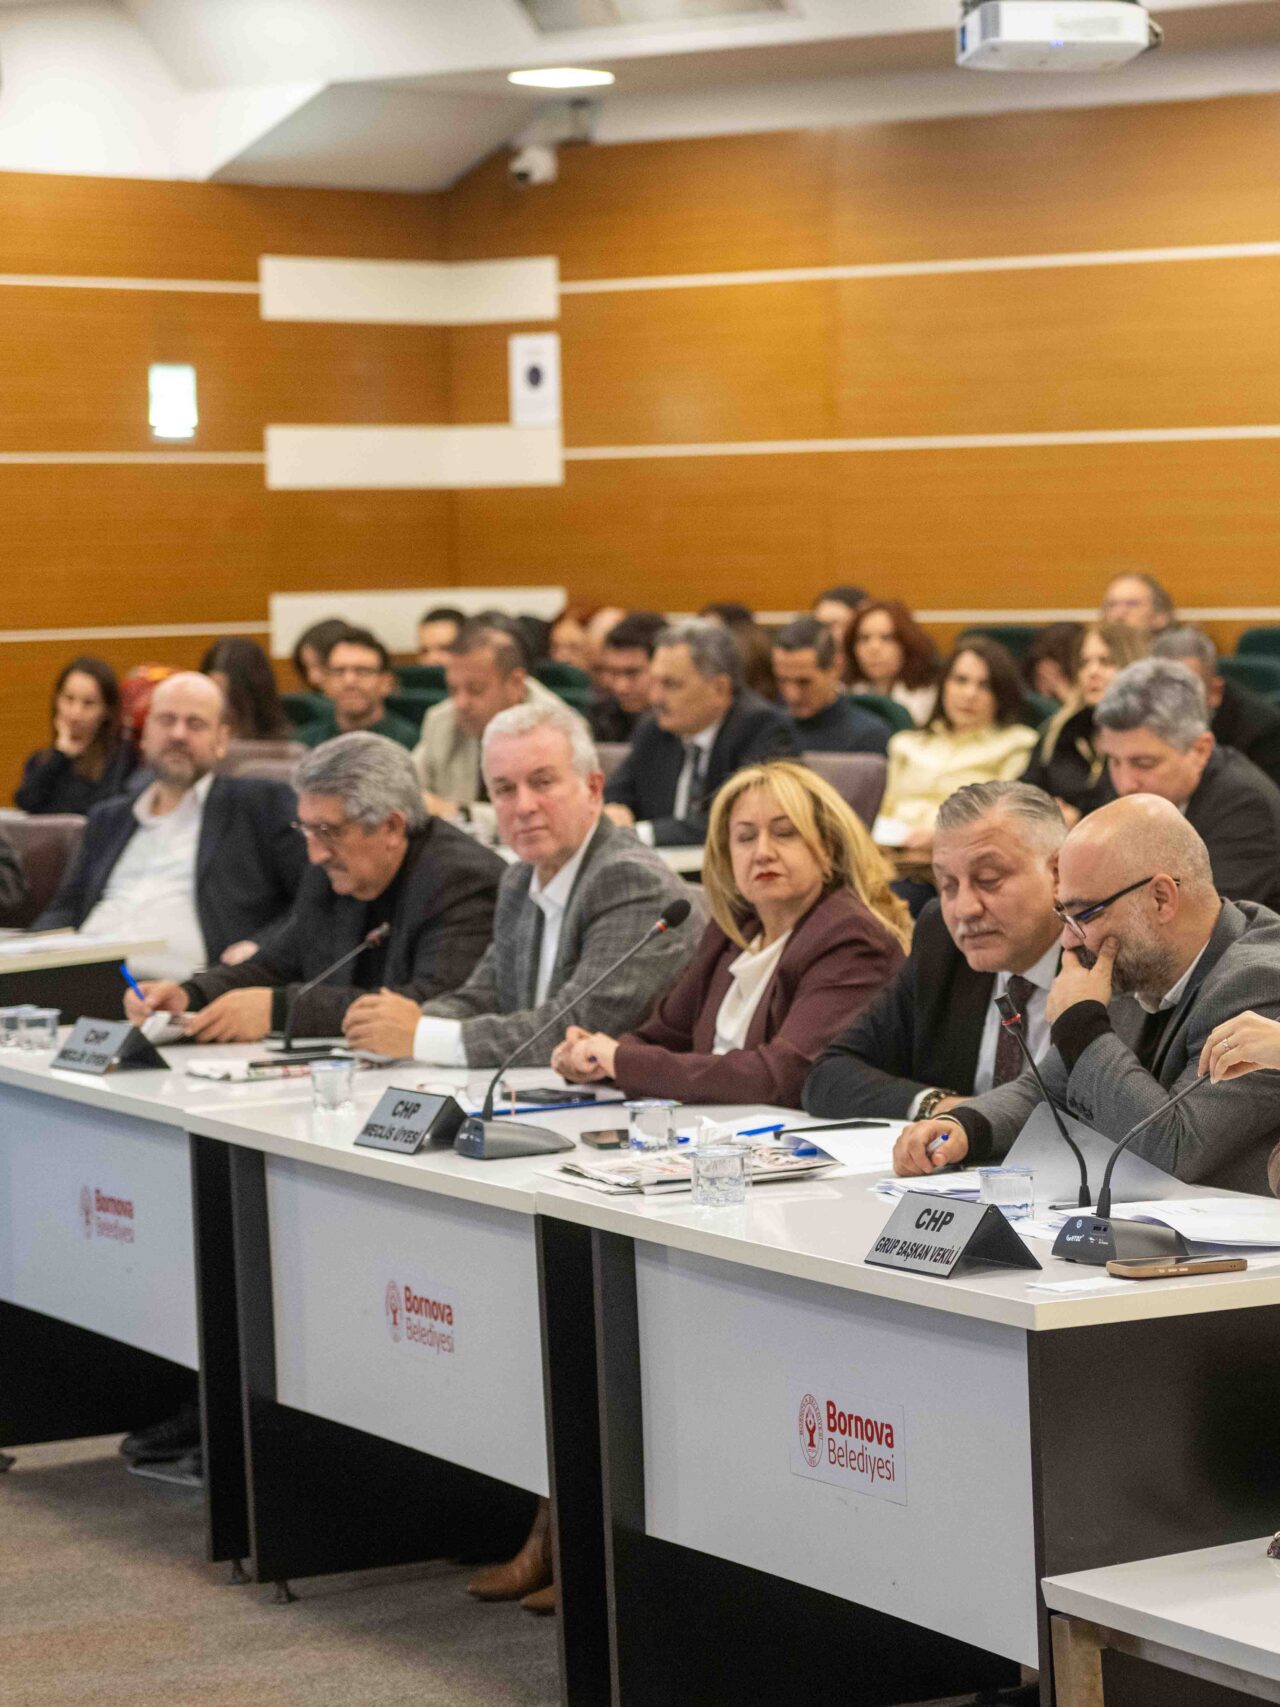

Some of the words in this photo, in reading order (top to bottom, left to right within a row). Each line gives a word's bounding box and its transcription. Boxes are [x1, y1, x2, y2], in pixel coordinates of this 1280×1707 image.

[392, 1101, 421, 1119] CHP
[95, 1188, 134, 1219] Bornova
[915, 1208, 954, 1232] CHP
[875, 1237, 901, 1254] GRUP
[896, 1240, 933, 1261] BAŞKAN
[928, 1245, 961, 1265] VEKİLİ
[404, 1285, 453, 1326] Bornova
[405, 1316, 454, 1355] Belediyesi
[826, 1400, 894, 1448] Bornova
[828, 1438, 895, 1483] Belediyesi
